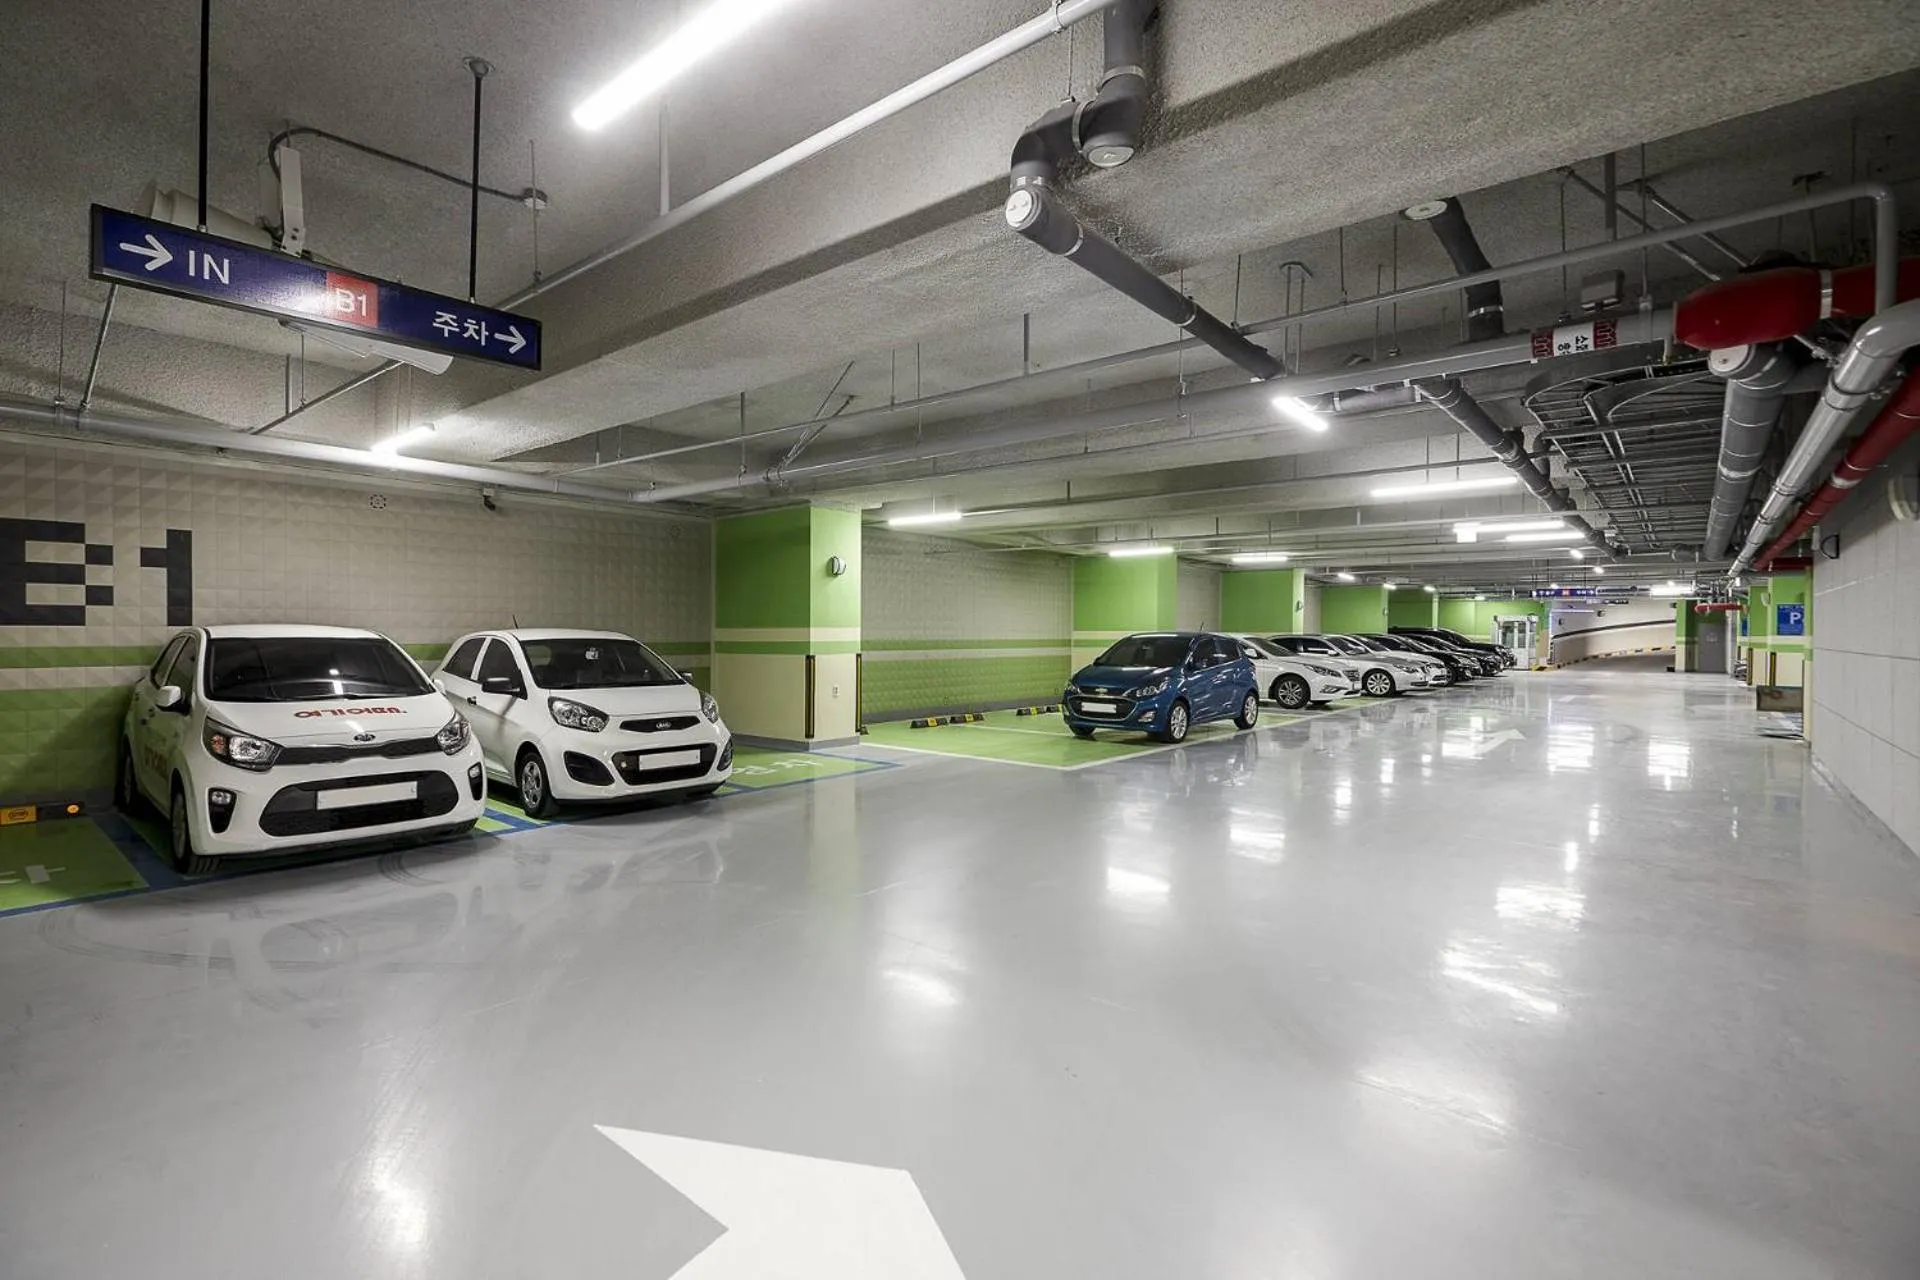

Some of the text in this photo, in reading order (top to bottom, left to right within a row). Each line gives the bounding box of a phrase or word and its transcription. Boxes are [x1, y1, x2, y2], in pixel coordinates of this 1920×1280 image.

[188, 249, 489, 346] IN B1 주차
[0, 518, 193, 626] B1
[1790, 612, 1802, 625] P
